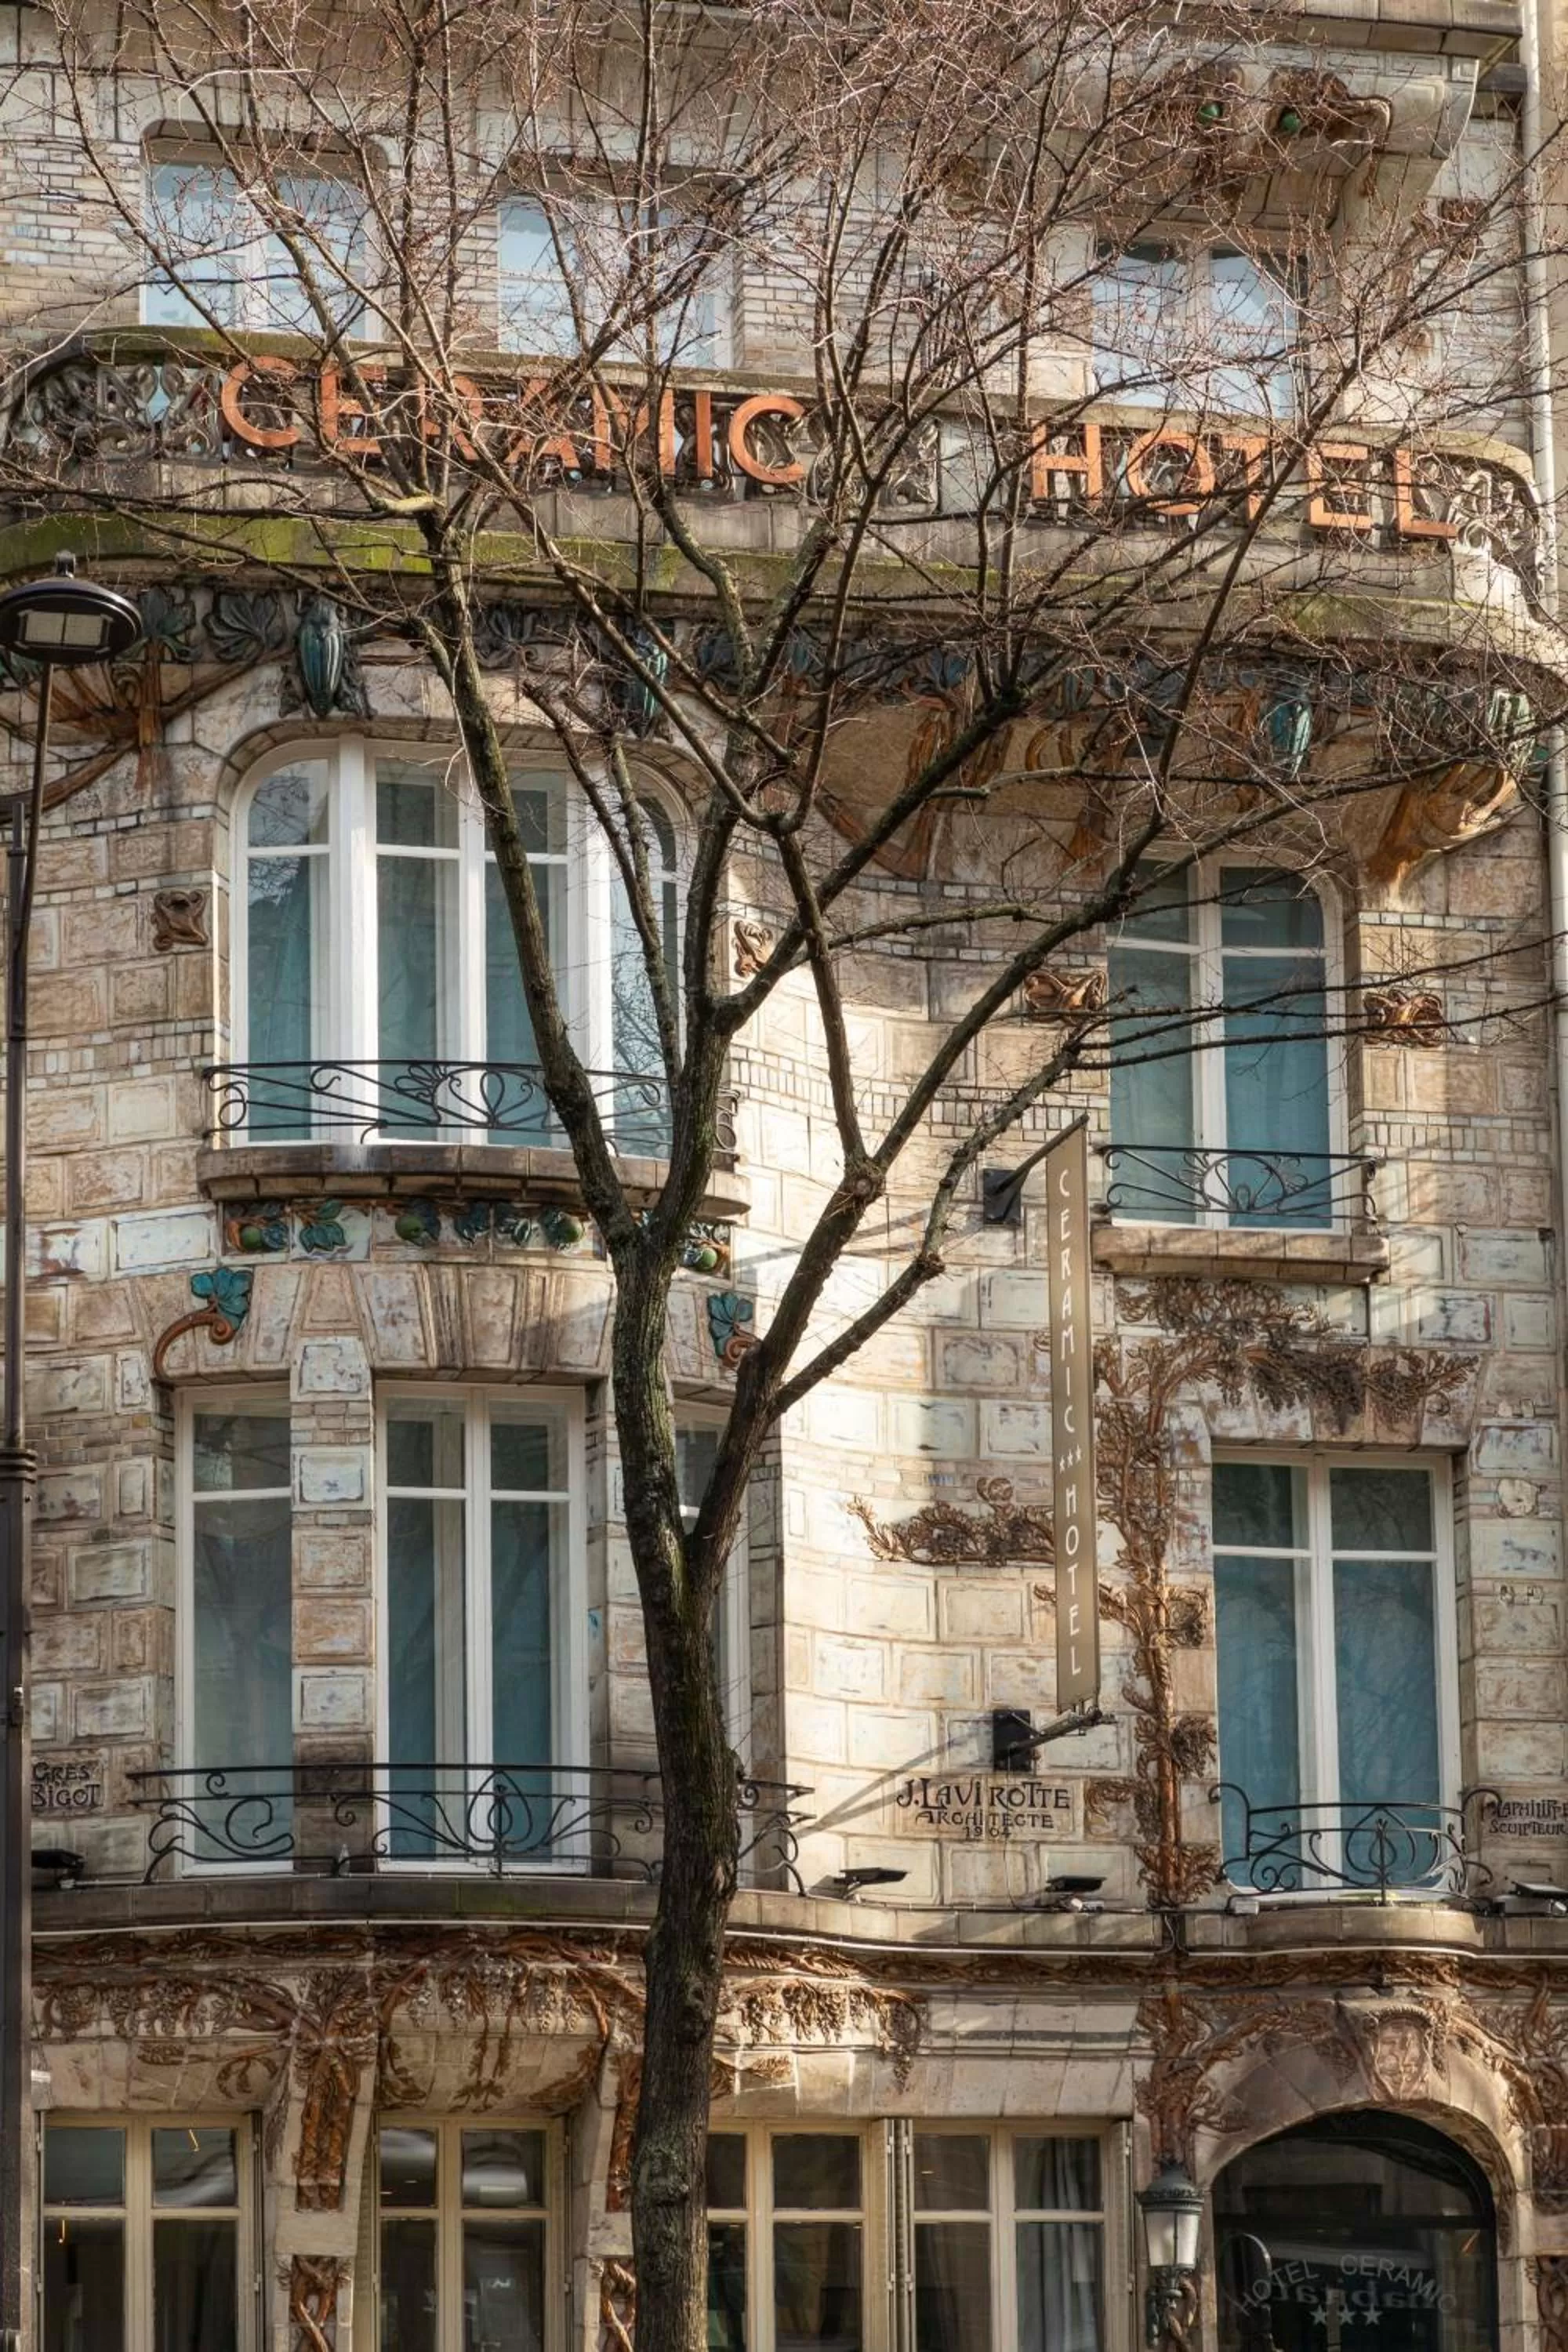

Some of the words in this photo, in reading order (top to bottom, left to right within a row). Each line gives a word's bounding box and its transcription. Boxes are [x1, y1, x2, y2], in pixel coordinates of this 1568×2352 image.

[1031, 419, 1458, 539] HOTEL
[1058, 1169, 1076, 1434] CERAMIC
[1065, 1483, 1082, 1676] HOTEL
[1230, 2258, 1320, 2318] HOTEL
[1339, 2253, 1457, 2314] CERAMIC
